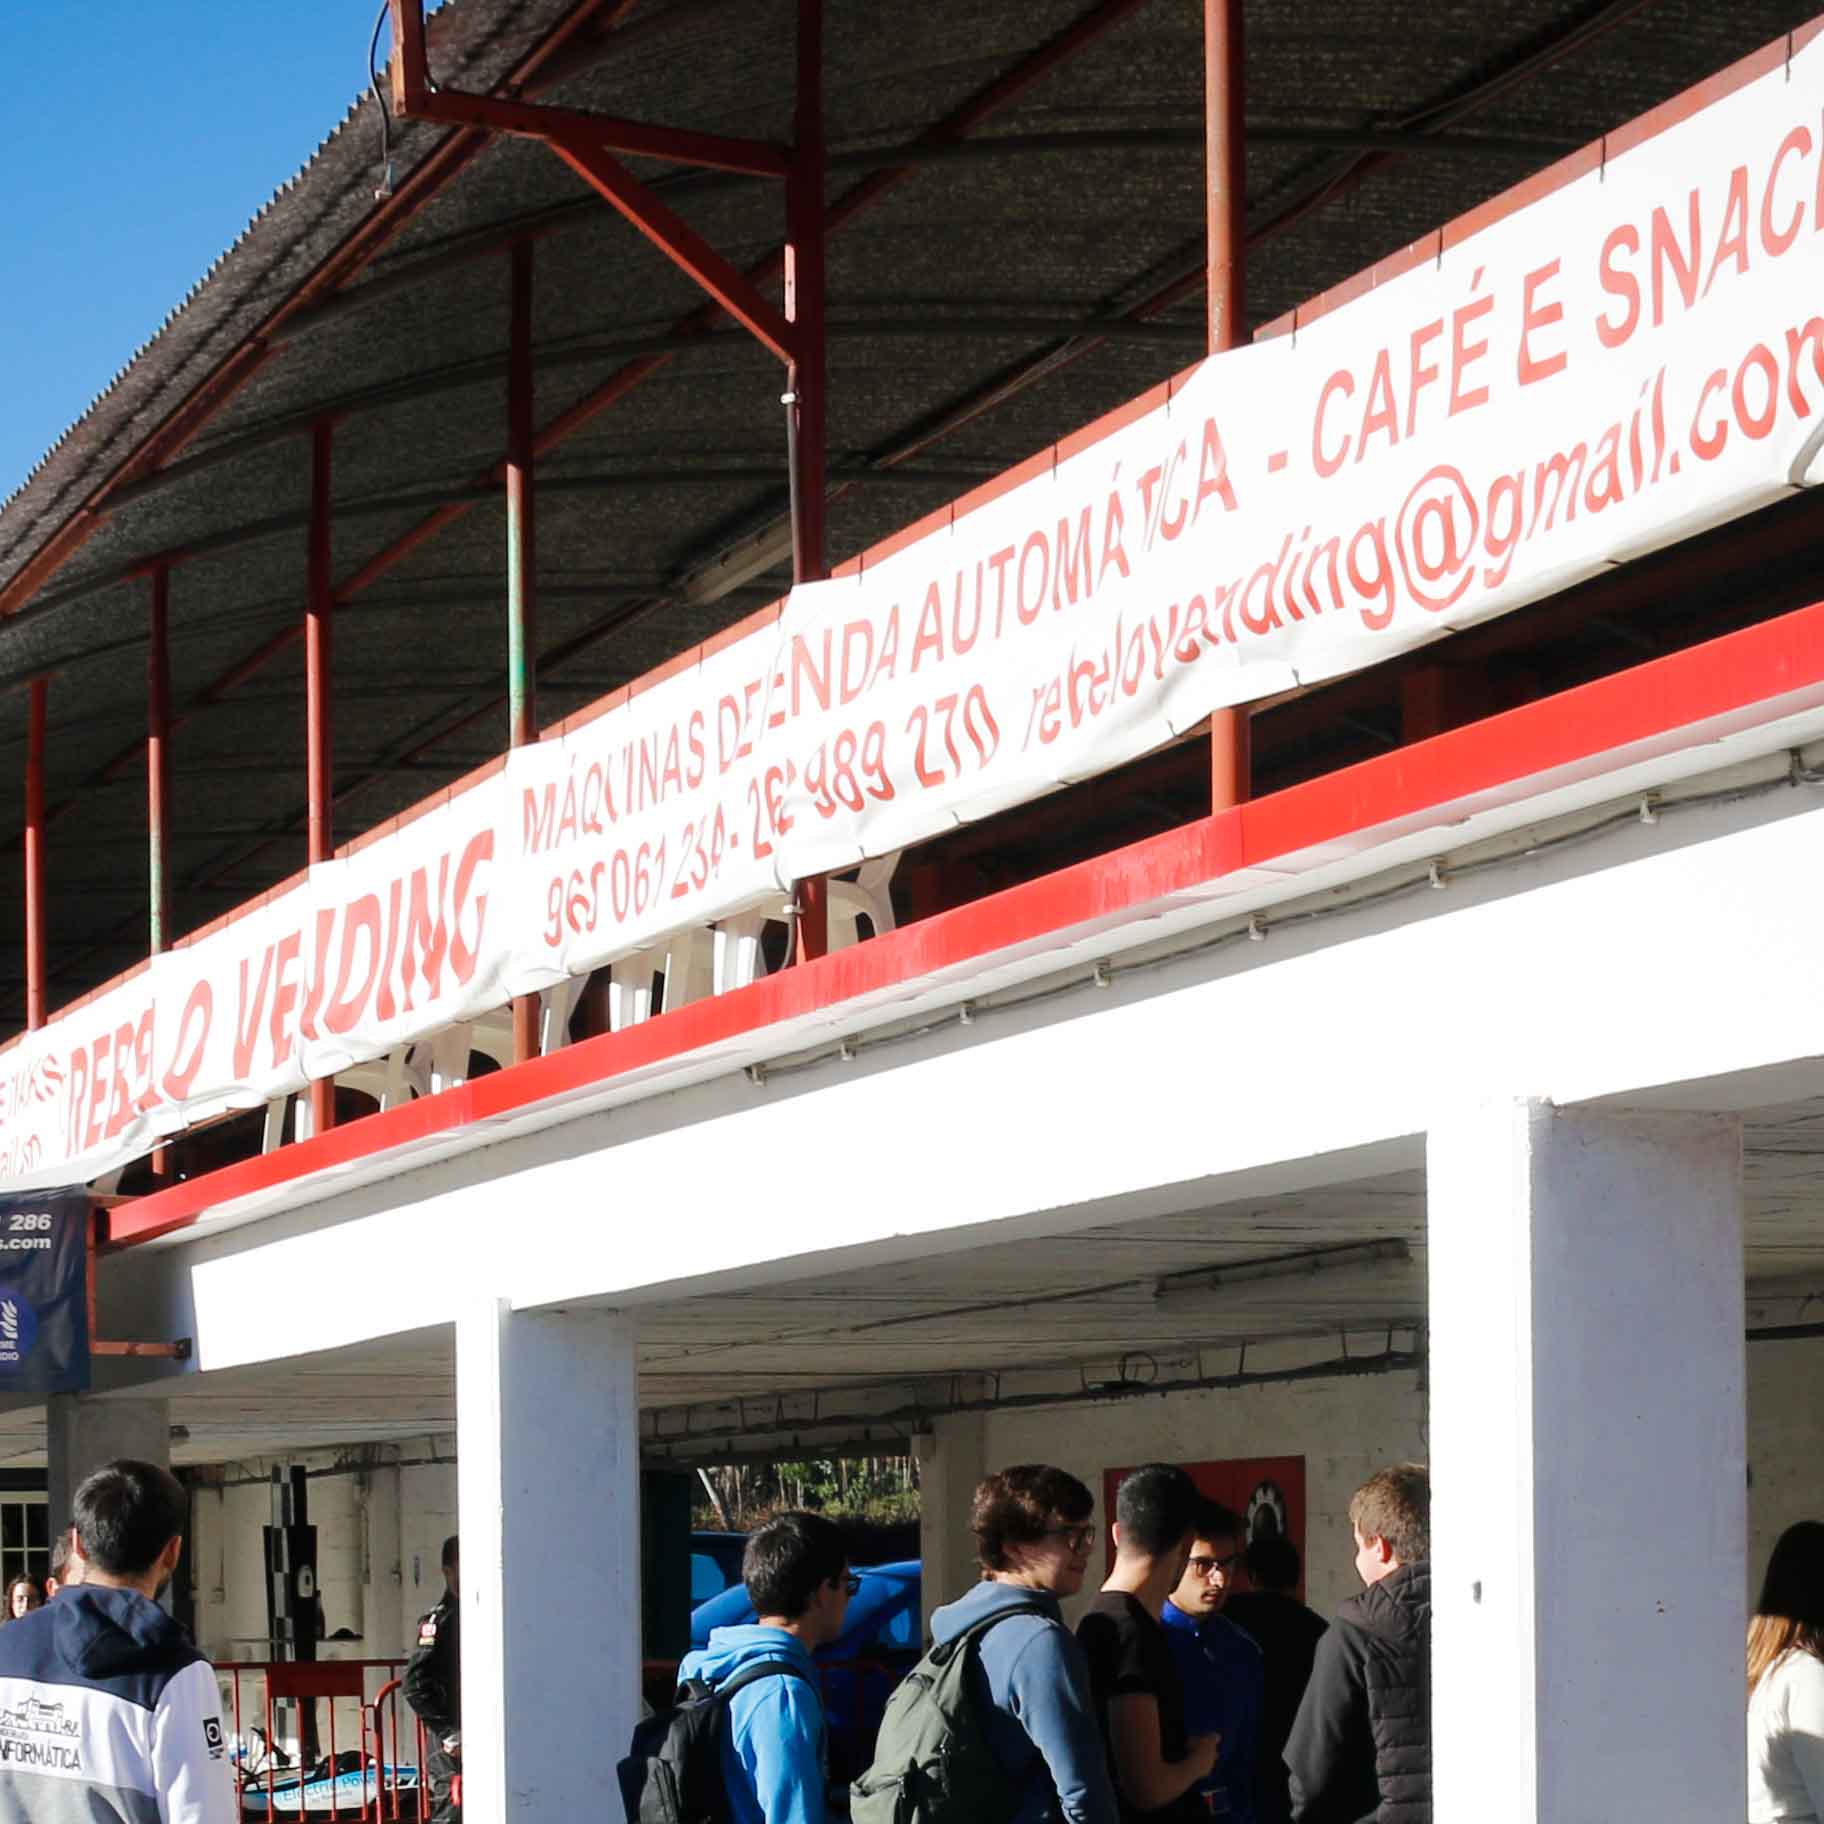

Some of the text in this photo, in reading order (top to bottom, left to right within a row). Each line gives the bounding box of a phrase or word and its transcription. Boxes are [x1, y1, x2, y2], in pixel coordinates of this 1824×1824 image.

[522, 710, 705, 856] MÁQUINAS
[1312, 265, 1495, 479] CAFÉ
[1517, 257, 1568, 387] E
[610, 831, 666, 925] 061
[803, 719, 896, 820] 989
[905, 683, 1001, 791] 270
[8, 1213, 52, 1231] 286
